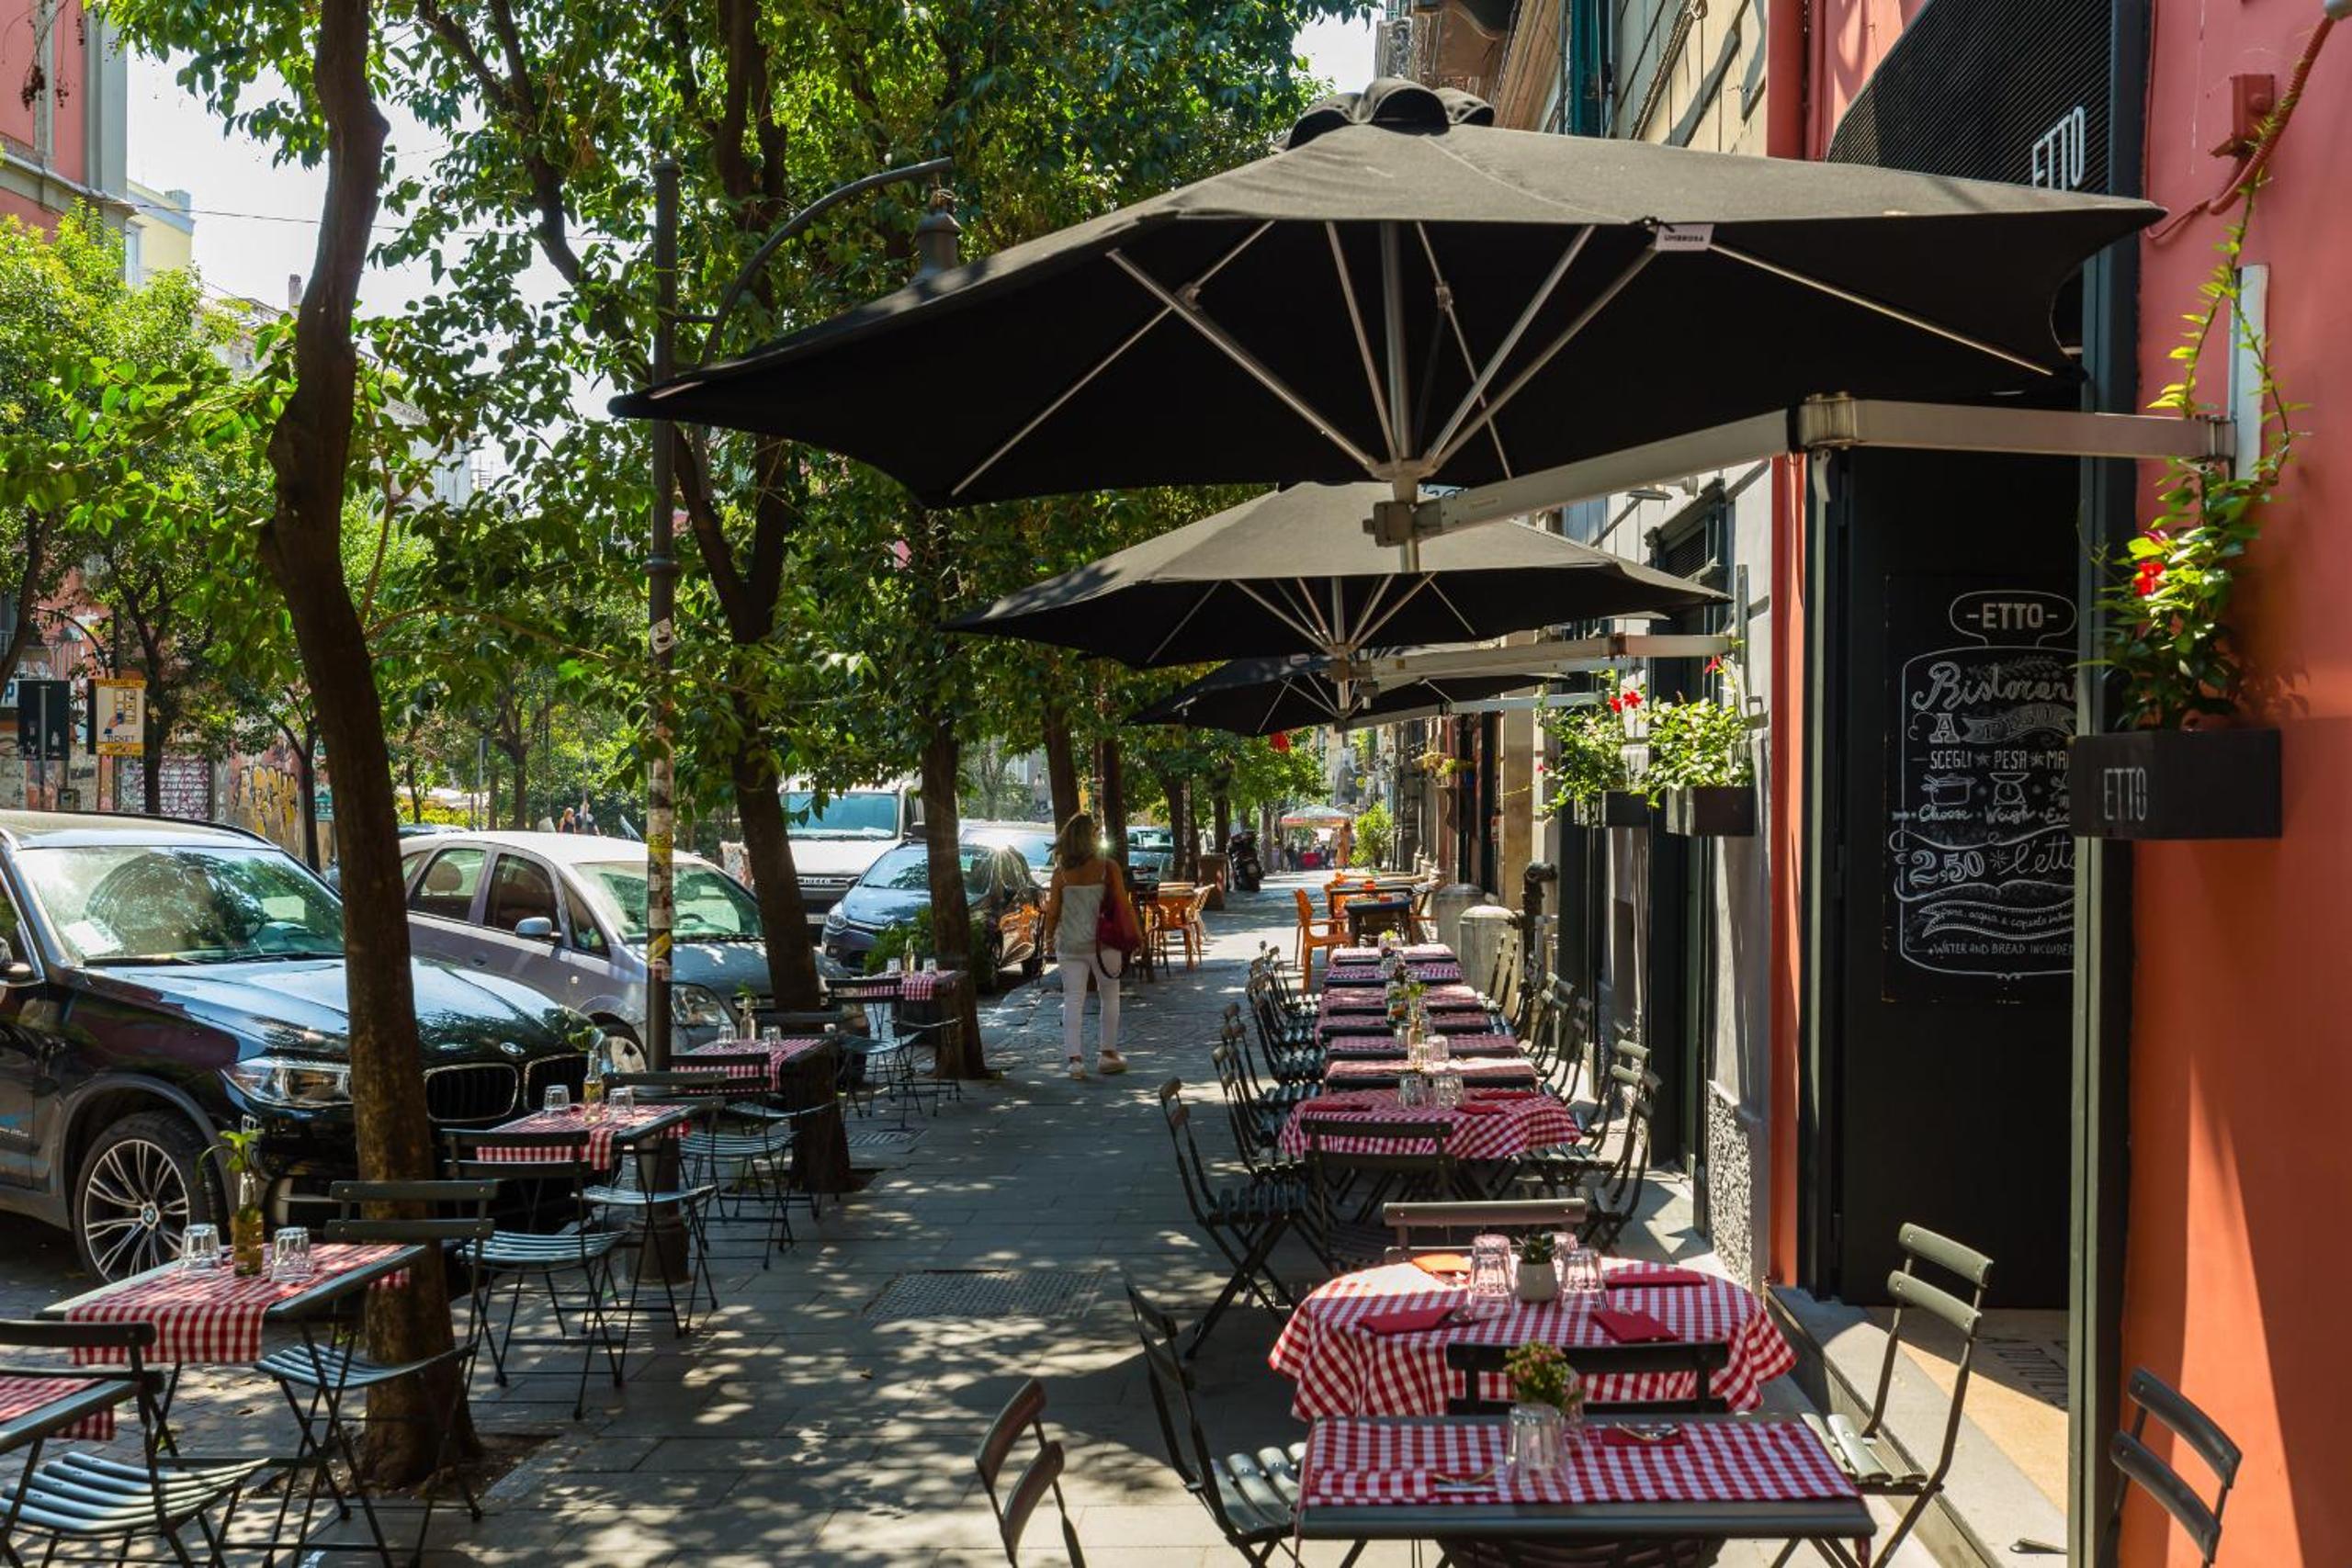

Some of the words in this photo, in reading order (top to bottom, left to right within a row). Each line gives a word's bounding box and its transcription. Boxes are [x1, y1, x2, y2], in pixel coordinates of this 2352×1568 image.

[2032, 106, 2086, 191] ETTO
[1929, 750, 1973, 770] SCEGLI
[1994, 750, 2028, 770] PESA
[2046, 750, 2069, 770] MA
[2104, 767, 2147, 822] ETTO
[1918, 804, 1973, 822] Choose
[1933, 941, 1967, 954] WATER
[1969, 942, 1989, 954] AND
[1991, 942, 2026, 954] BREAD
